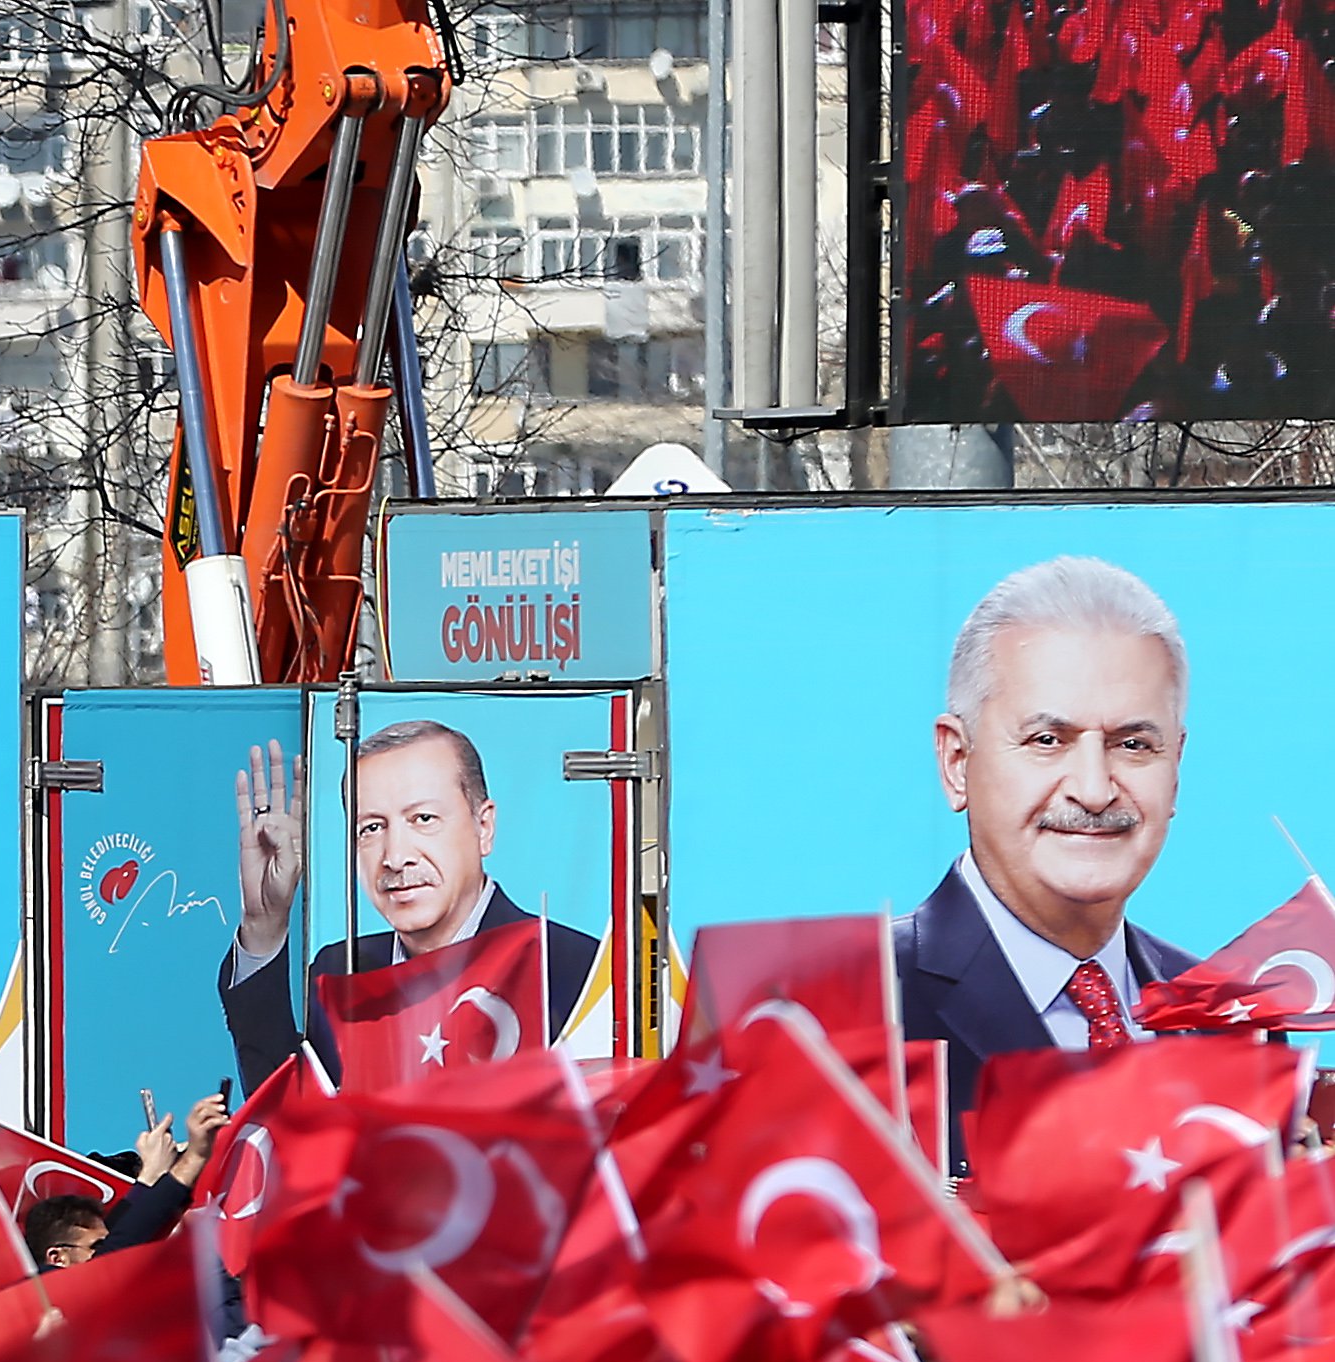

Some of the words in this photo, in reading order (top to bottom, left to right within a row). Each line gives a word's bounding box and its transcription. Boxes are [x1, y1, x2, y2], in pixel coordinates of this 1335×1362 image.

[441, 548, 551, 588] MEMLEKET
[553, 540, 579, 592] İŞİ
[441, 594, 543, 663] GÖNÜL
[545, 593, 580, 672] İŞİ
